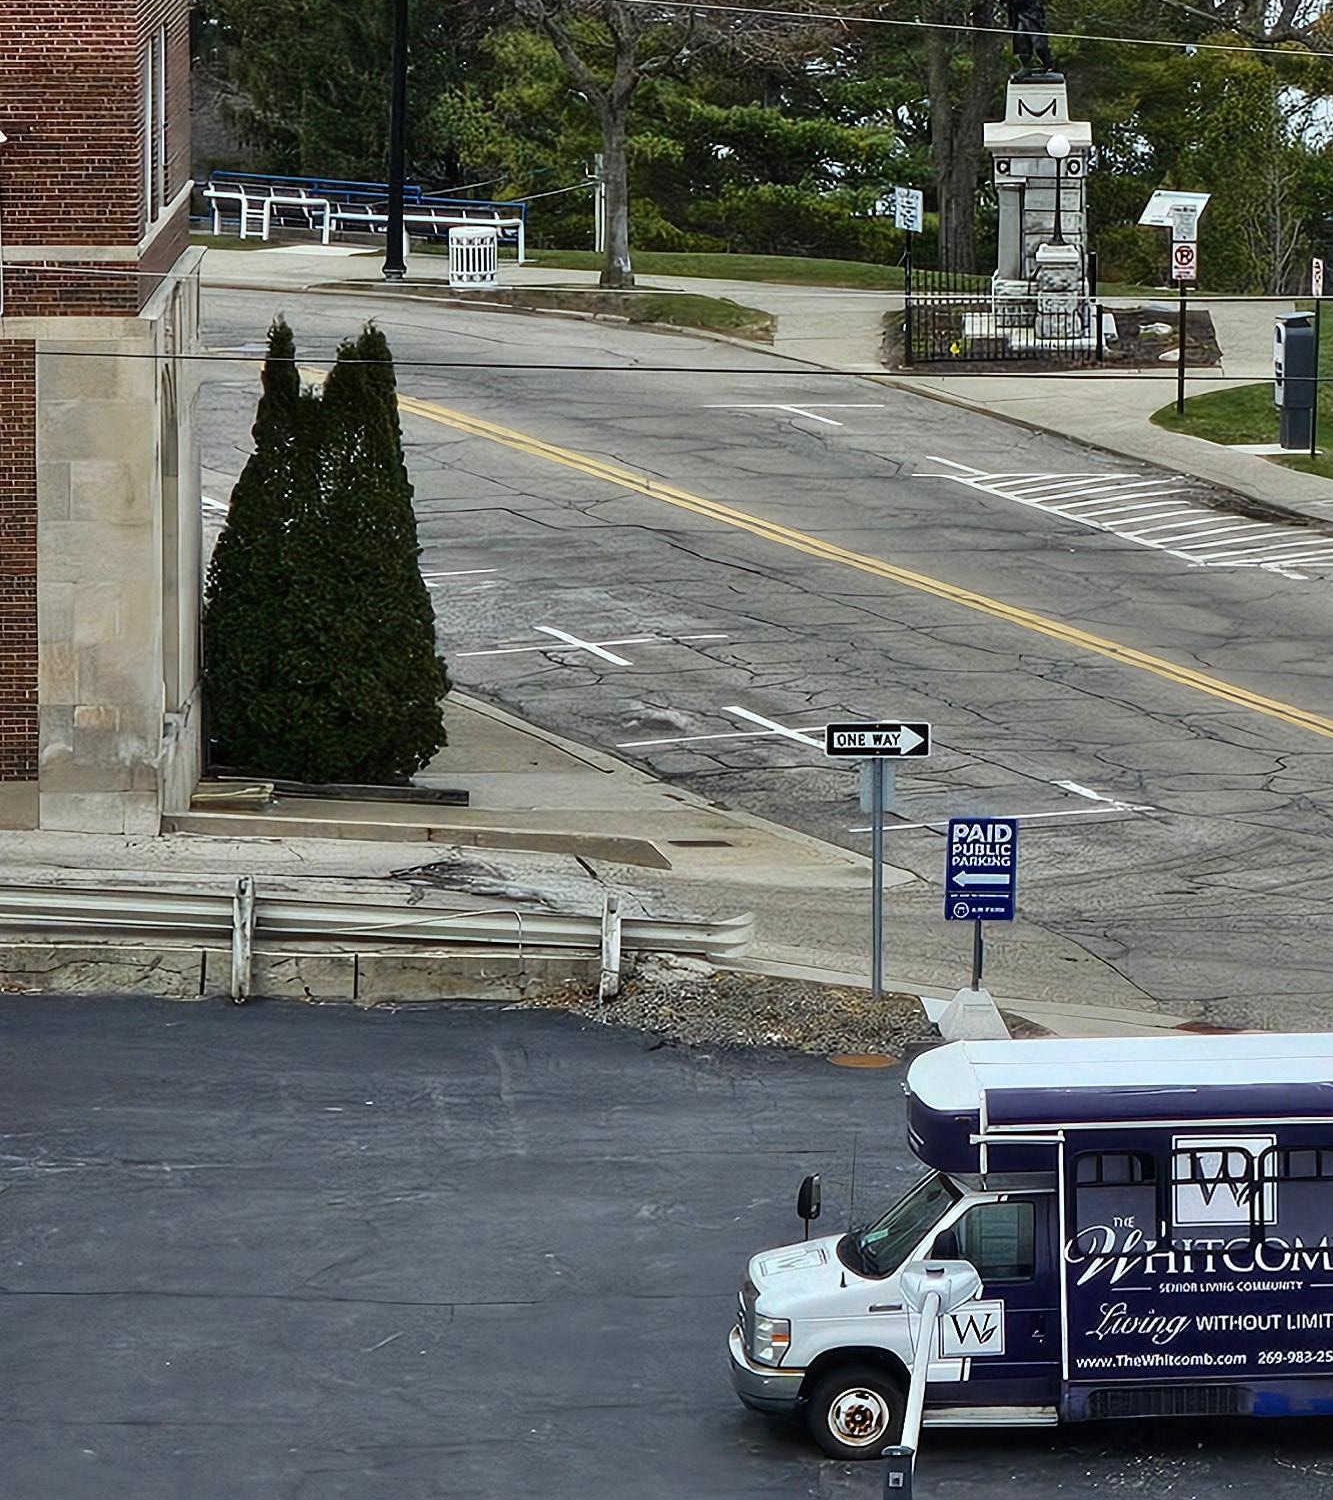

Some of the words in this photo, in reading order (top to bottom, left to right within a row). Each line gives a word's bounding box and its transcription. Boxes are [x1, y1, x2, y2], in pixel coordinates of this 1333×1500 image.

[836, 733, 866, 747] ONE
[872, 733, 901, 747] WAY
[952, 823, 1013, 843] PAID
[952, 843, 1012, 856] PUBLIC
[951, 856, 1011, 867] PARKING
[1113, 1215, 1135, 1228] THE
[1159, 1283, 1198, 1293] SENIOR
[1199, 1282, 1234, 1293] LIVING
[1236, 1281, 1304, 1292] COMMUNITY
[950, 1312, 997, 1345] W
[1085, 1301, 1192, 1345] Living
[1195, 1314, 1282, 1331] WITHOUT
[1076, 1353, 1247, 1368] www.TheWhitcomb.com
